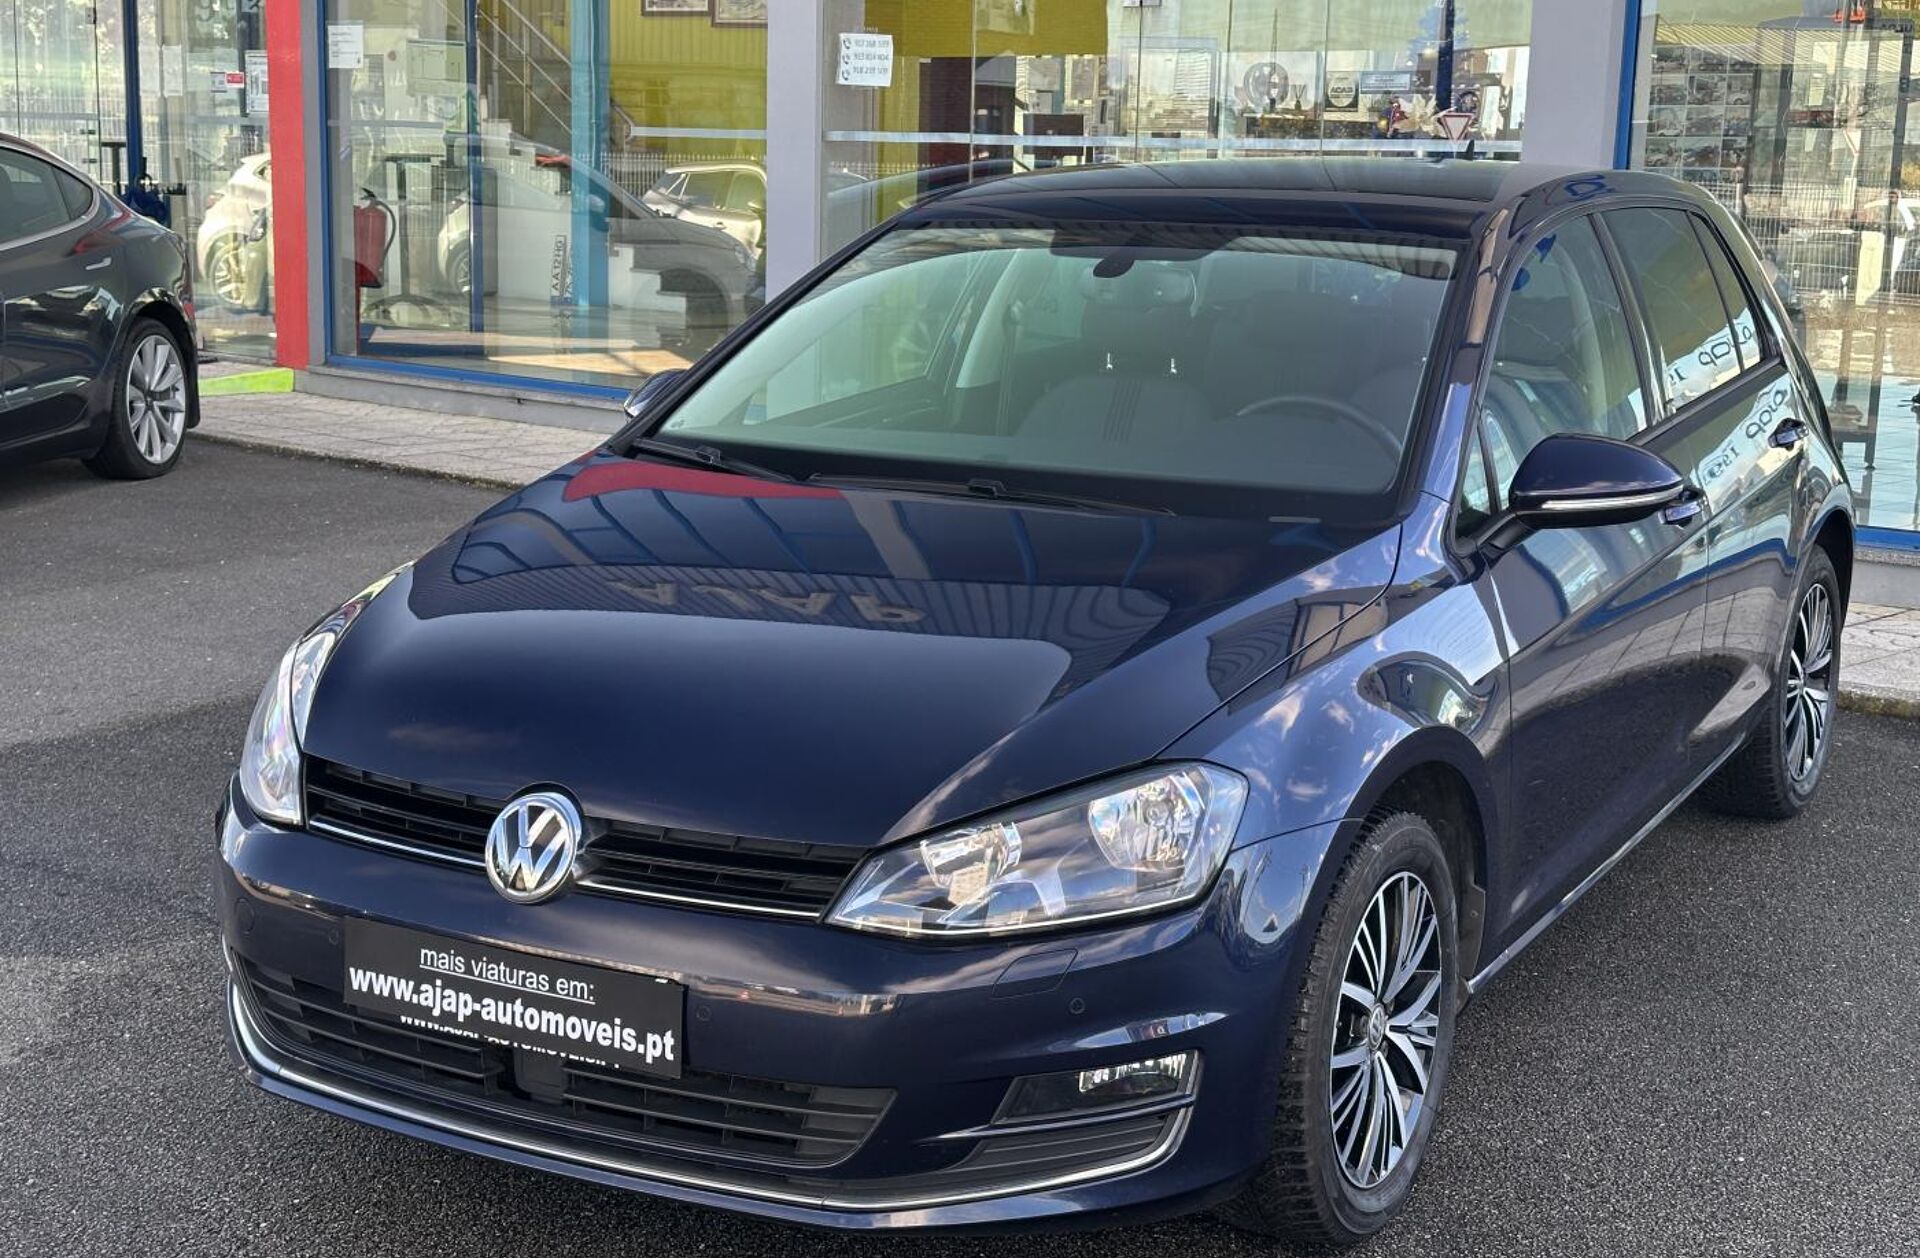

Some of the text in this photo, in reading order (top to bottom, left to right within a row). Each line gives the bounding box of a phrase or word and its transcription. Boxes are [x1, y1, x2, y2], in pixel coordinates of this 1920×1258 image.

[420, 948, 595, 1001] mais viaturas em:
[349, 966, 675, 1064] www.ajap-automoveis.pt
